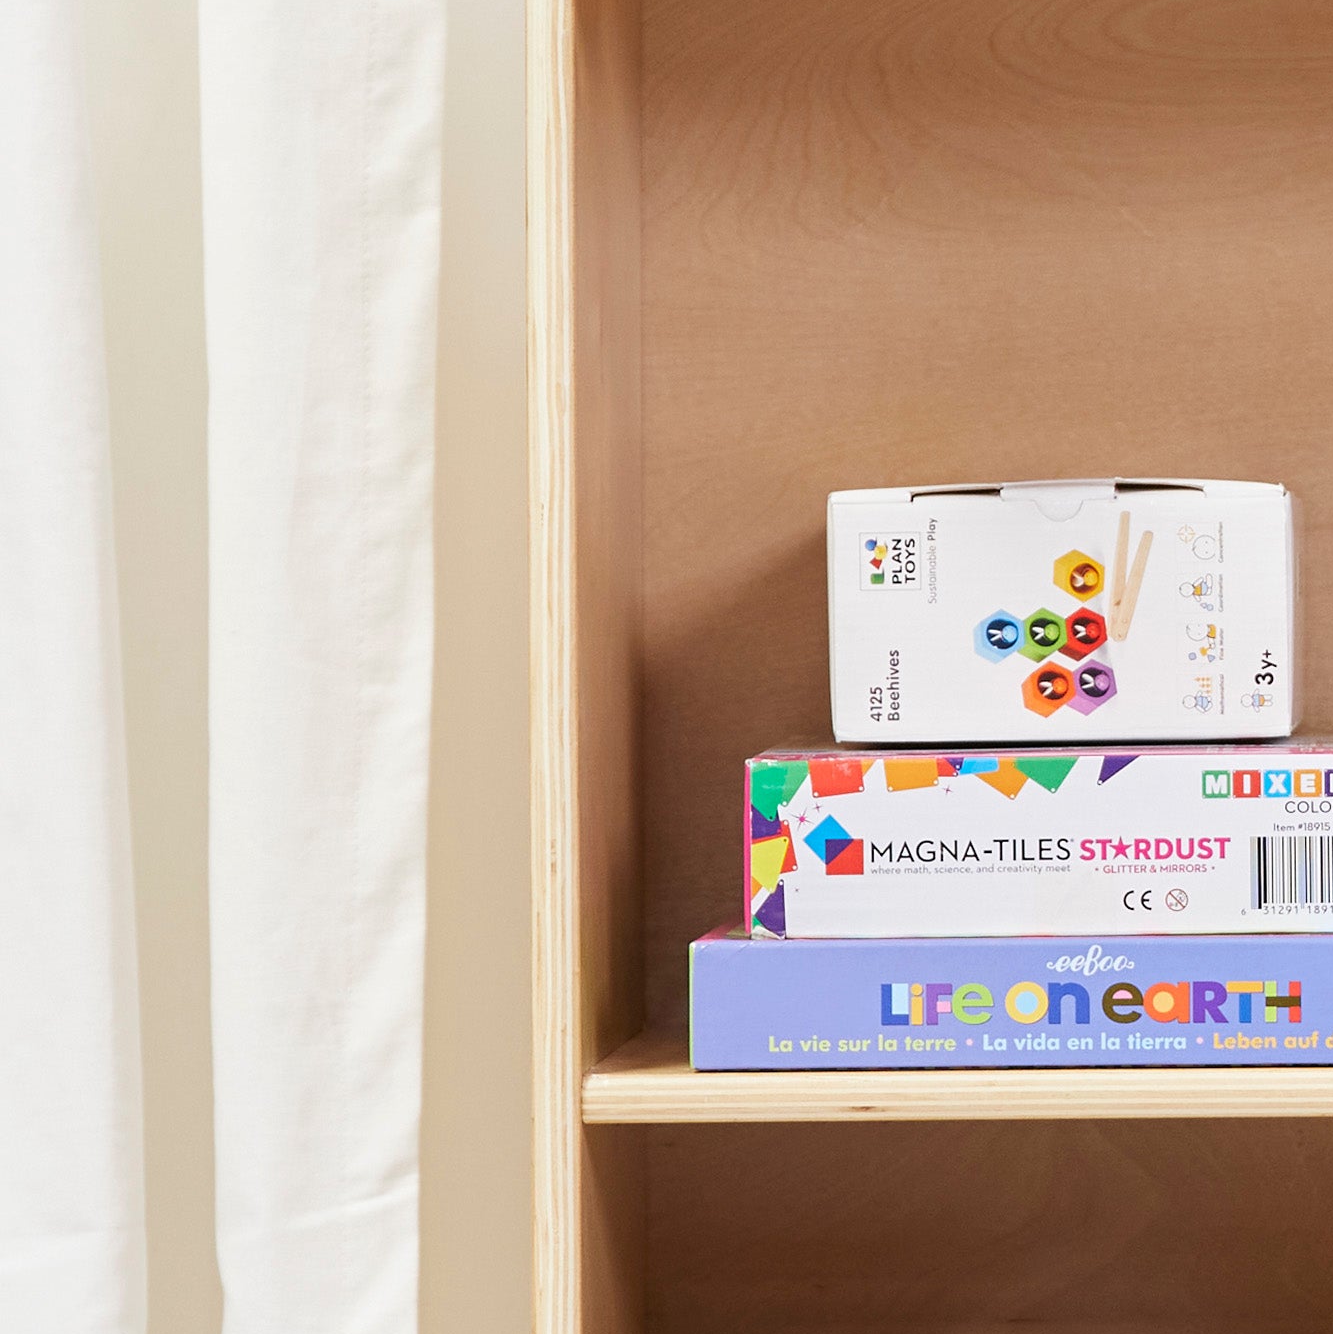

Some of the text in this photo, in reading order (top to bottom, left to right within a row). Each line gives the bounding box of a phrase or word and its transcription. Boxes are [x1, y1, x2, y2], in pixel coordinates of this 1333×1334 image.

[892, 539, 902, 584] PLAN
[904, 538, 915, 584] TOYS
[927, 517, 938, 604] Sustainable Play
[886, 649, 900, 721] Beehives
[870, 686, 883, 722] 4125
[1273, 822, 1331, 832] Item #18915
[871, 839, 1071, 863] MAGNA-TILES
[871, 864, 1071, 875] where math, science, and creativity meet
[1103, 864, 1207, 874] GLITTER & MIRRORS
[1263, 905, 1299, 915] 31291
[768, 1035, 793, 1052] La
[800, 1035, 831, 1052] vie
[838, 1037, 871, 1052] sur
[878, 1034, 898, 1051] la
[905, 1035, 957, 1052] terre
[983, 1033, 1007, 1051] La
[1013, 1033, 1060, 1050] vida
[1066, 1036, 1094, 1050] en
[1101, 1032, 1121, 1050] la
[1127, 1032, 1187, 1050] tierra
[1213, 1031, 1277, 1049] Leben
[1284, 1030, 1319, 1049] auf
